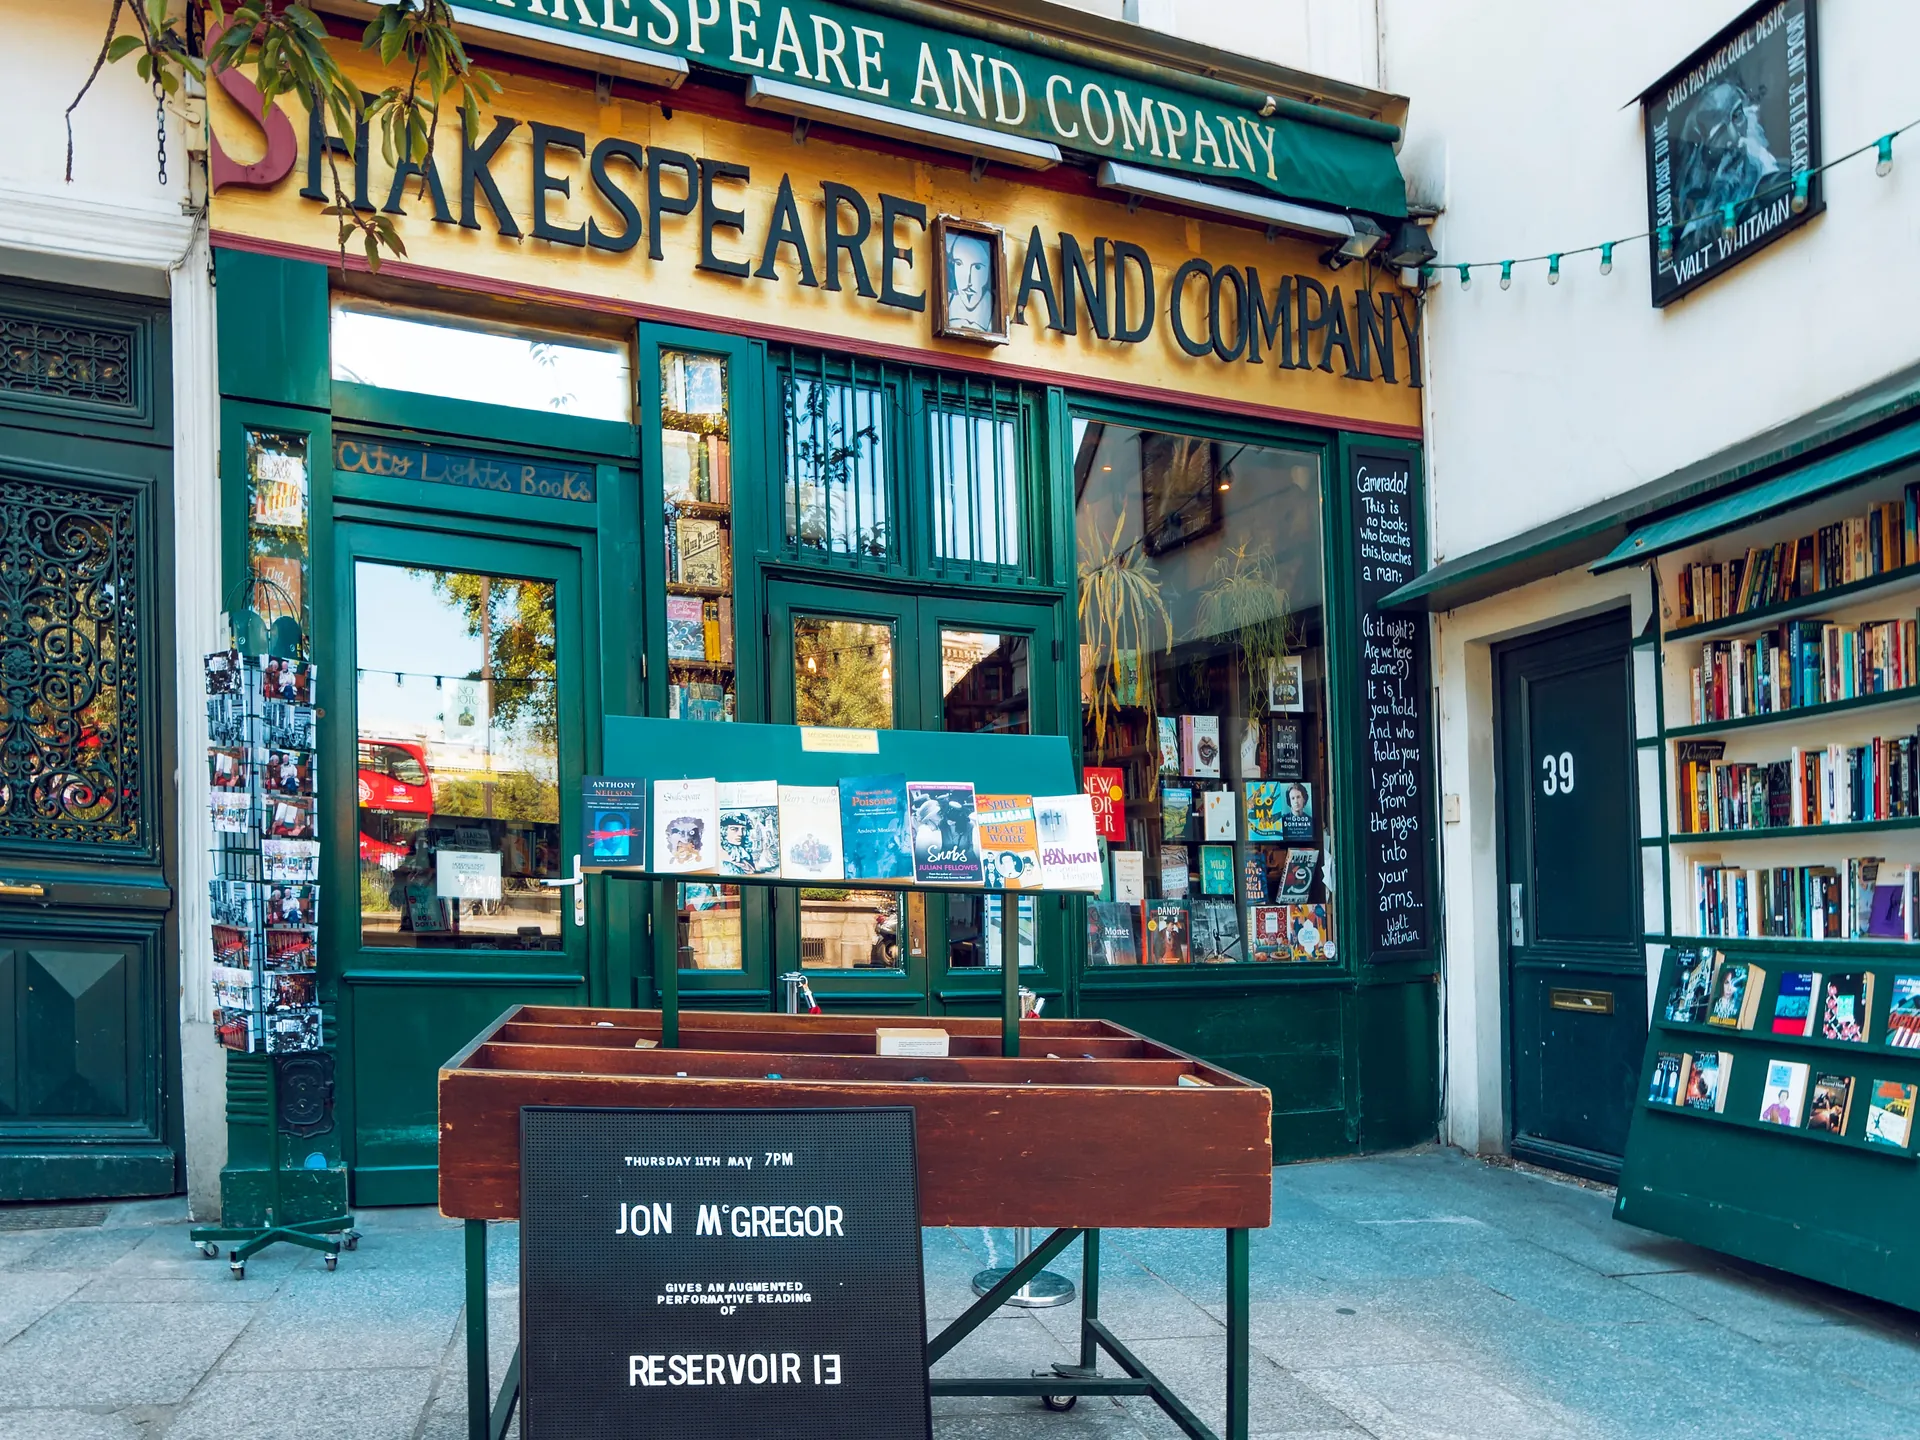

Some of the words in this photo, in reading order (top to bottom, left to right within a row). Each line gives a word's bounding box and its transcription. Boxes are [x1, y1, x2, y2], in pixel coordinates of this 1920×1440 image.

[910, 40, 1027, 127] AND
[1046, 74, 1278, 181] COMPANY
[208, 22, 928, 313] SHAKESPEARE
[1012, 224, 1155, 344] AND
[1169, 257, 1423, 389] COMPANY
[1673, 243, 1714, 286] WALT
[1717, 193, 1791, 261] WHITMAN
[338, 440, 414, 477] City
[420, 453, 512, 493] Lights
[1356, 466, 1409, 495] Camerado!
[1362, 496, 1386, 515] This
[1390, 498, 1400, 515] is
[1366, 516, 1379, 528] no
[1380, 516, 1408, 533] book;
[1359, 527, 1378, 542] Who
[1379, 528, 1412, 548] touches
[1380, 546, 1413, 567] touches
[1363, 565, 1373, 582] a
[1376, 566, 1404, 584] man;
[1362, 612, 1374, 638] (Is
[1377, 615, 1385, 634] it
[1386, 619, 1416, 645] night?
[1364, 640, 1380, 659] Are
[1381, 646, 1393, 659] we
[1392, 642, 1413, 661] here
[1370, 658, 1410, 681] alone?)
[1367, 679, 1377, 700] It
[1383, 680, 1394, 698] is
[1369, 704, 1390, 722] you
[1368, 720, 1392, 740] And
[1396, 719, 1415, 740] who
[1373, 741, 1400, 762] holds
[1381, 769, 1417, 797] spring
[1542, 751, 1575, 796] 39
[592, 781, 637, 789] ANTHONY
[595, 789, 633, 797] NEILSON
[1083, 776, 1114, 794] NEW
[852, 796, 897, 807] Poisoner
[987, 798, 1019, 811] SPIKE
[1090, 795, 1115, 814] OR
[1255, 797, 1273, 807] GO
[1378, 788, 1407, 814] from
[1093, 814, 1116, 832] ER
[1255, 809, 1273, 819] MY
[986, 825, 1027, 835] PEACE
[1370, 811, 1388, 833] the
[1390, 814, 1419, 841] pages
[989, 834, 1026, 844] WORK
[927, 844, 968, 863] Snobs
[1043, 851, 1098, 866] RANKIN
[1381, 840, 1408, 864] into
[1210, 859, 1227, 870] WILD
[1213, 870, 1225, 881] AIR
[1378, 867, 1409, 894] your
[1157, 906, 1181, 916] DANDY
[1104, 926, 1130, 937] Monet
[1386, 914, 1409, 932] Walt
[1381, 929, 1420, 947] Whitman
[624, 1156, 692, 1167] THURSDAY
[694, 1156, 721, 1167] 11TH
[727, 1156, 753, 1170] MAY
[764, 1152, 794, 1167] 7PM
[615, 1202, 673, 1236] JON
[665, 1283, 703, 1293] GIVES
[707, 1283, 725, 1293] AN
[728, 1282, 804, 1293] AUGMENTED
[657, 1294, 754, 1305] PERFORMATIVE
[757, 1293, 812, 1304] READING
[720, 1305, 737, 1316] OF
[628, 1352, 802, 1387] RESERVOIR
